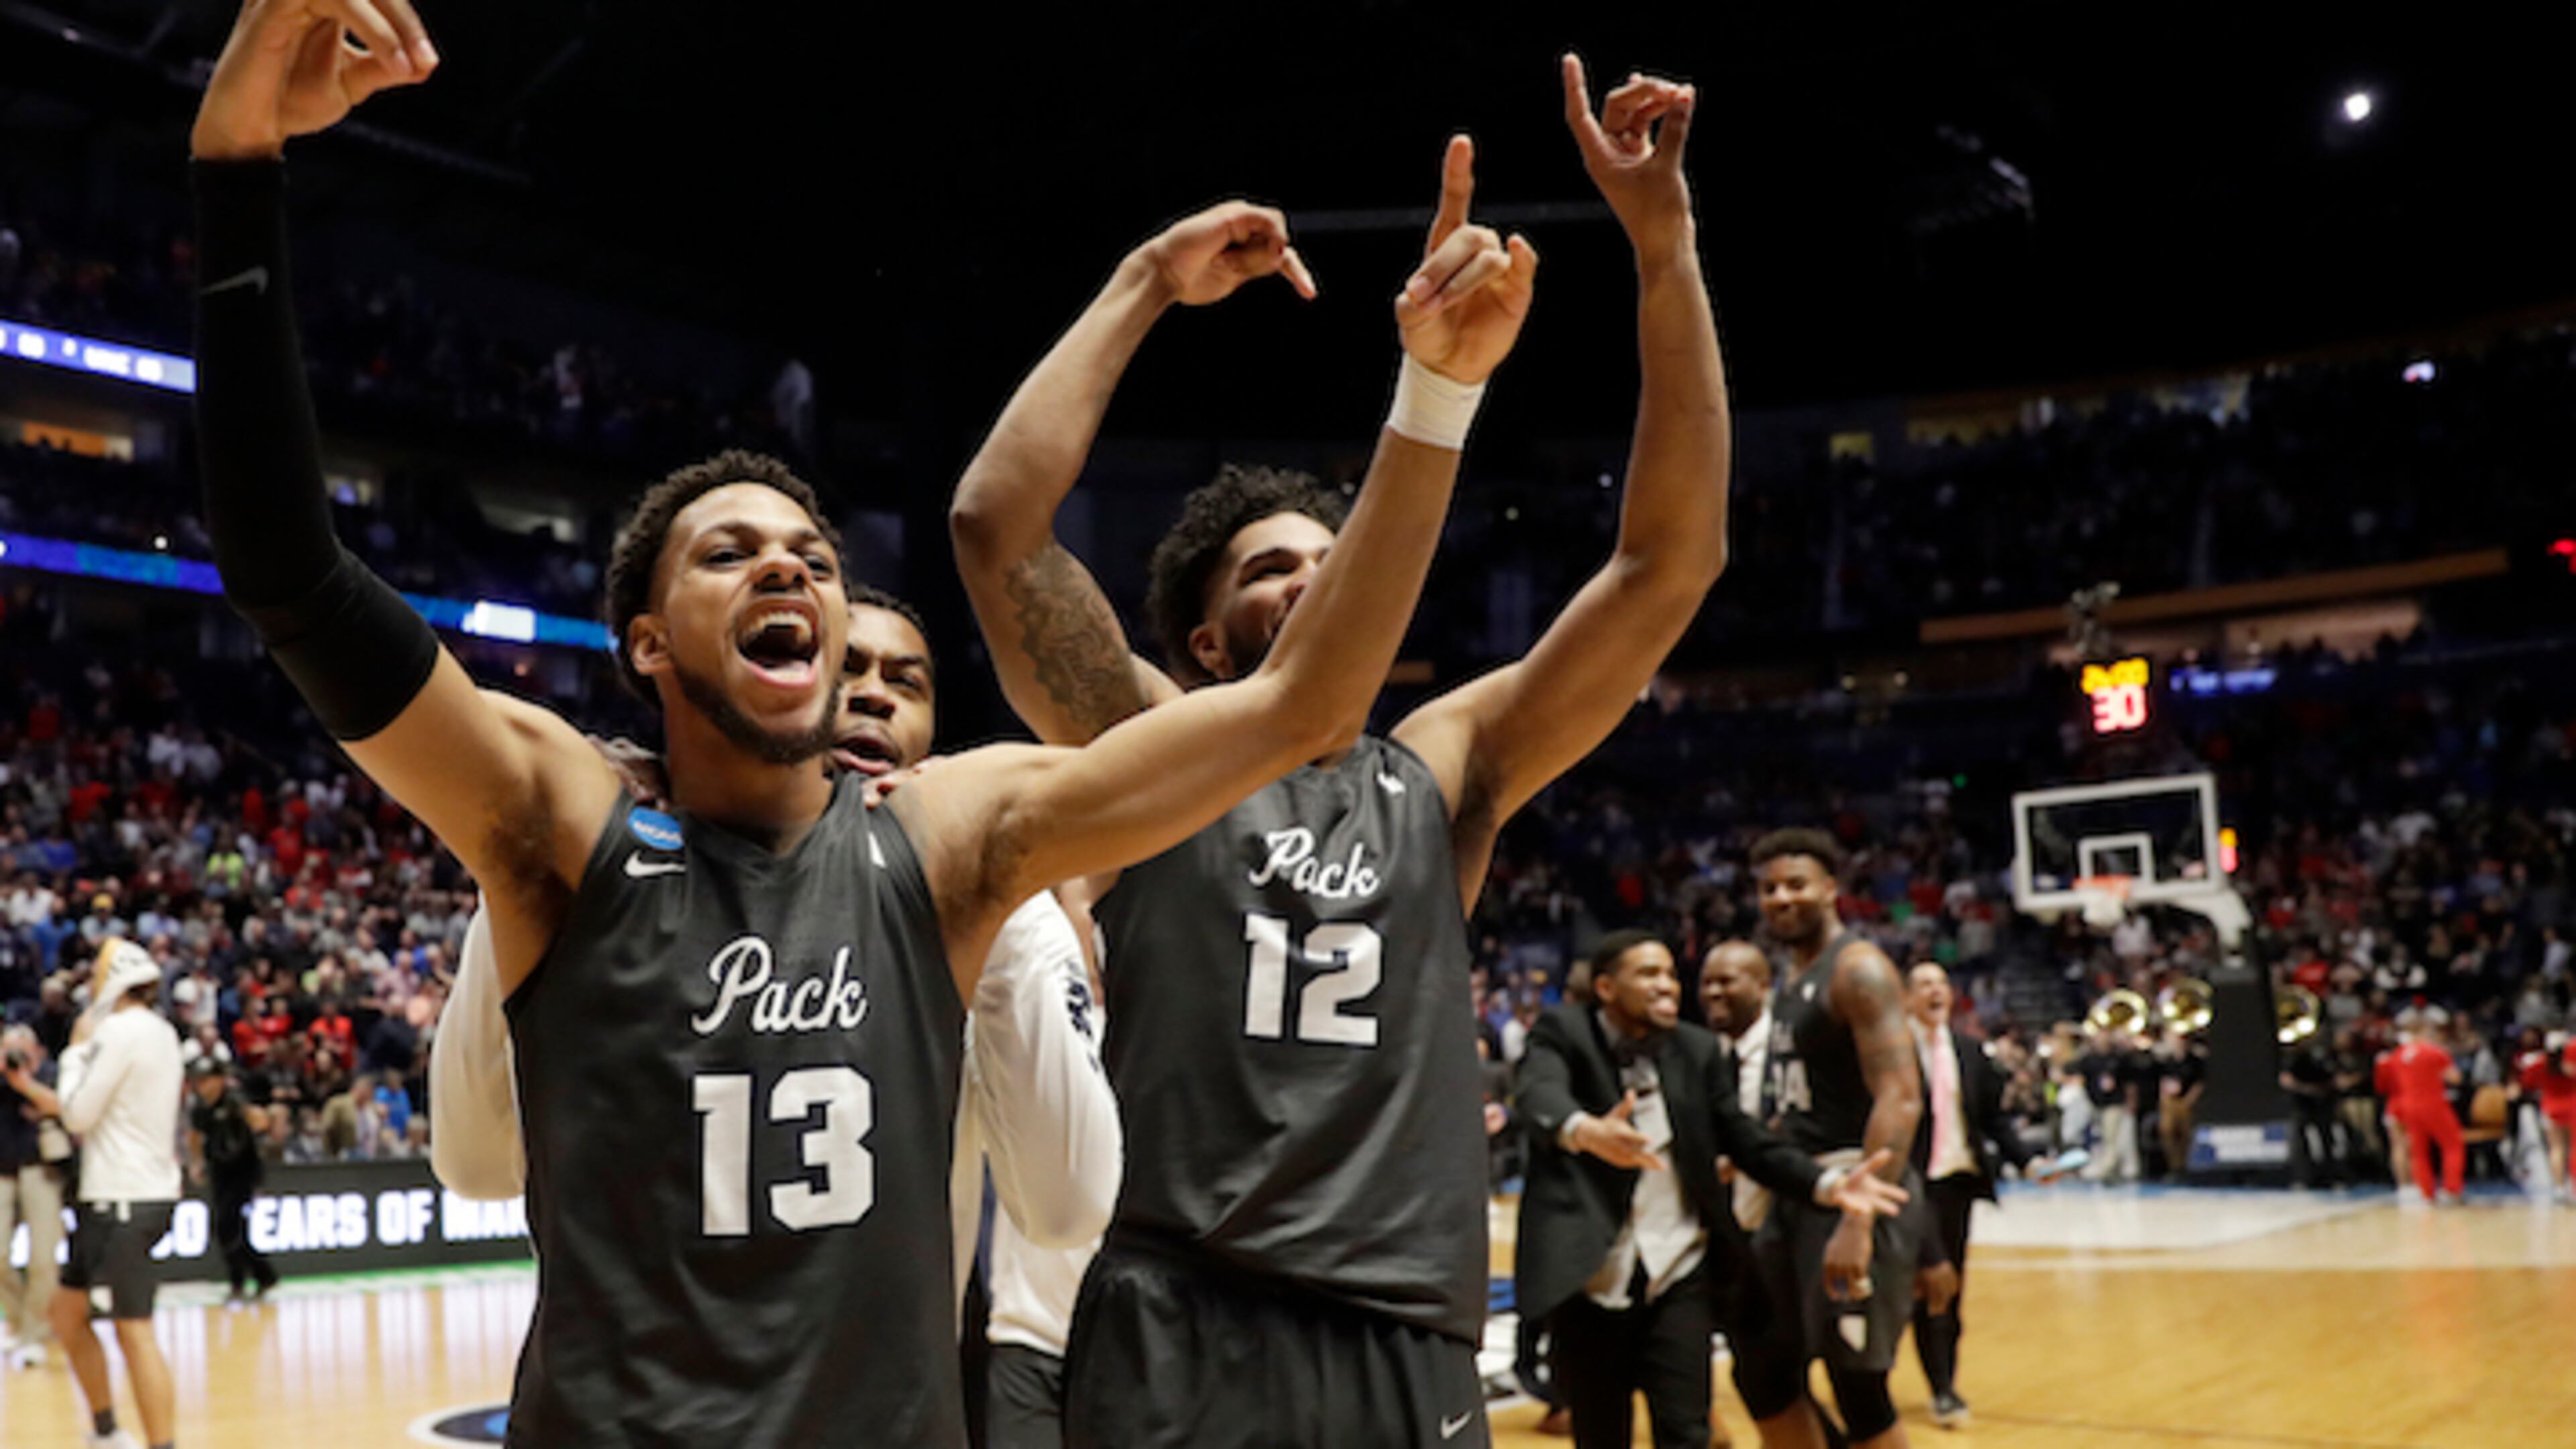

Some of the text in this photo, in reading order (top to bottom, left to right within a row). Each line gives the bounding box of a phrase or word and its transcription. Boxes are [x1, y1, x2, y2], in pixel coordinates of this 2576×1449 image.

[2092, 685, 2147, 733] 30
[1249, 826, 1379, 898] Pack
[692, 936, 867, 1034] Pack
[1244, 912, 1381, 1046] 12
[693, 1067, 874, 1236] 13
[241, 1192, 368, 1252] EARS
[376, 1189, 435, 1246] OF
